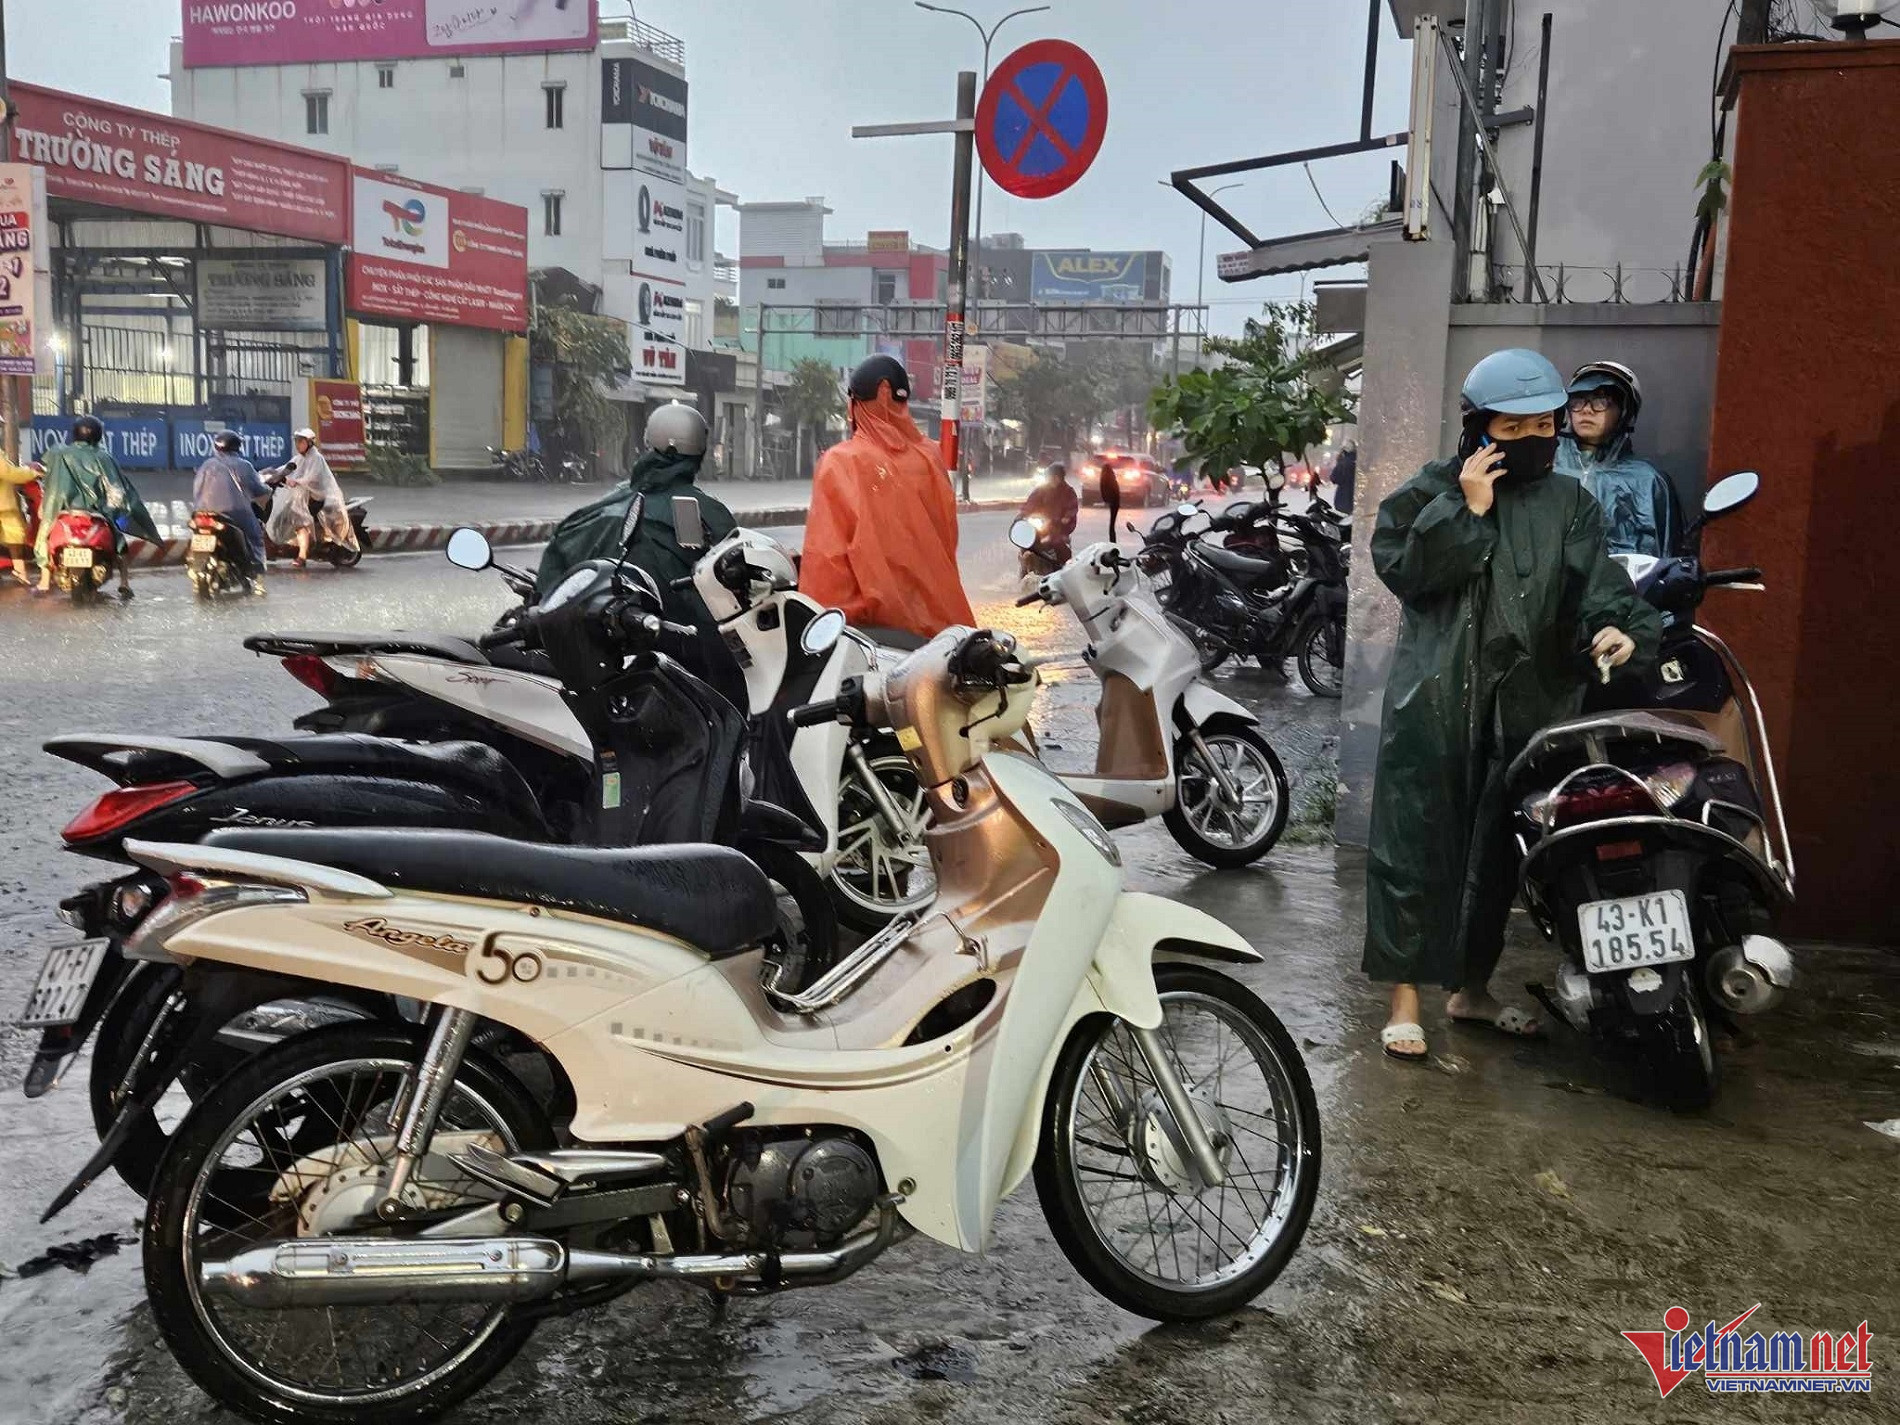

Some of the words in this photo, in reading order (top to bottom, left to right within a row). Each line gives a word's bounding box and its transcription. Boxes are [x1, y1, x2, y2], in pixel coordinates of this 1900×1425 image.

[189, 1, 296, 24] HAWONKOO
[63, 110, 112, 135] CÔNG
[115, 122, 136, 140] TY
[15, 126, 136, 180] TRƯỜNG
[143, 149, 226, 197] SÁNG
[1058, 257, 1119, 273] ALEX
[121, 426, 157, 457] THÉP
[253, 430, 285, 458] THÉP
[1596, 896, 1668, 934] 43-K1
[342, 917, 470, 954] Angela
[476, 930, 542, 985] 50
[1591, 926, 1686, 967] 185.54
